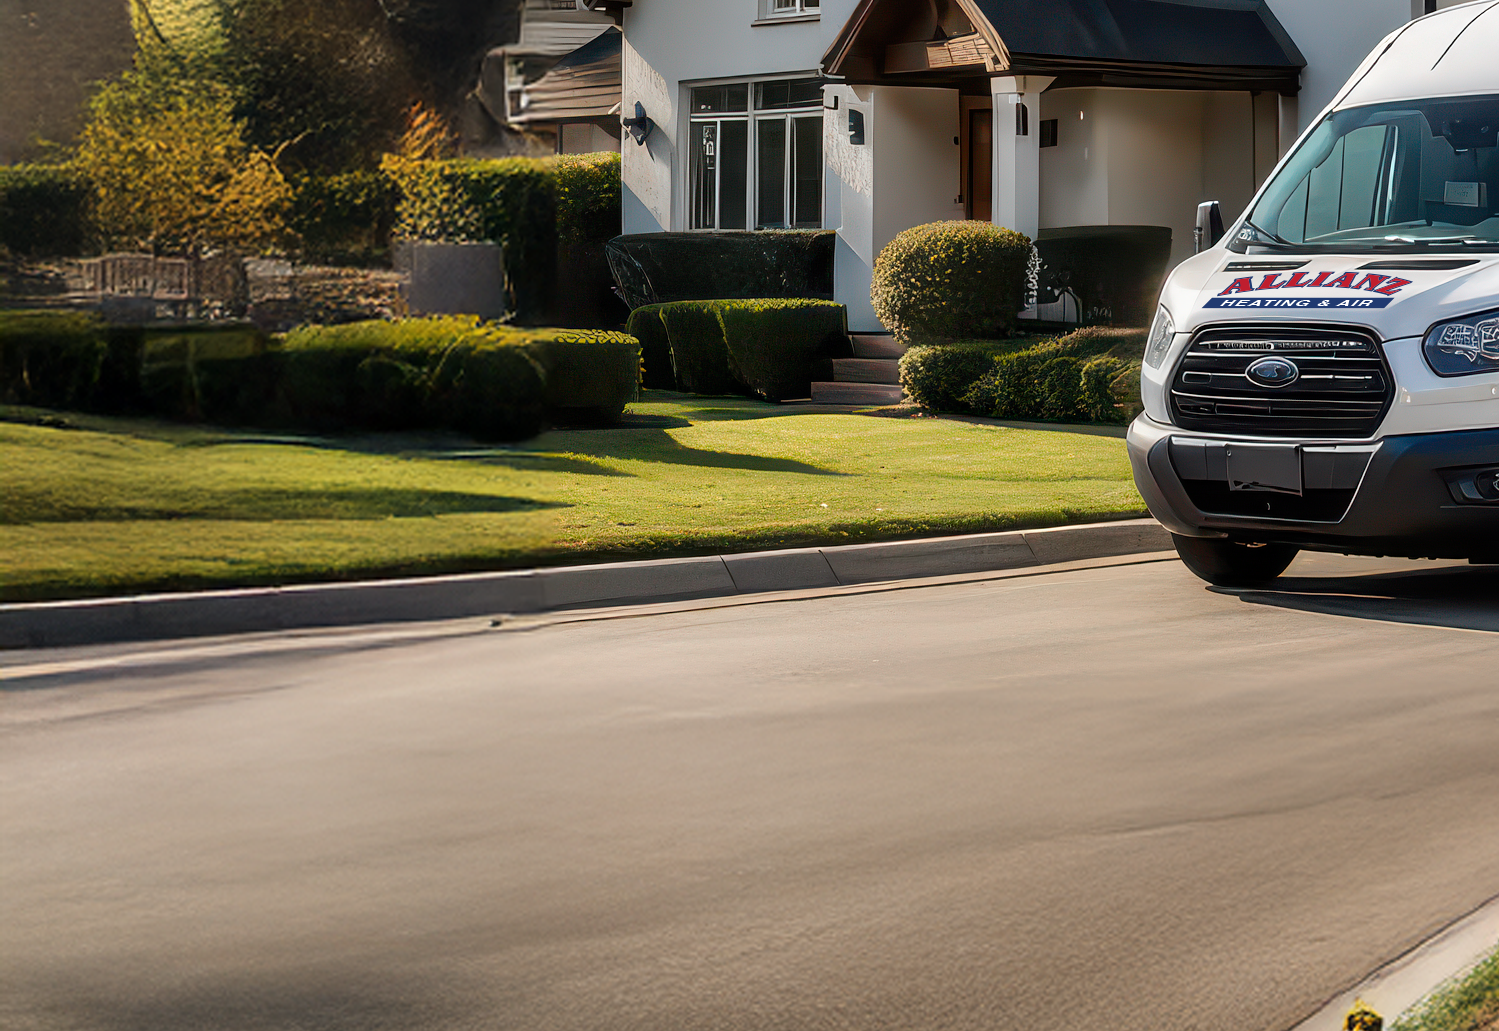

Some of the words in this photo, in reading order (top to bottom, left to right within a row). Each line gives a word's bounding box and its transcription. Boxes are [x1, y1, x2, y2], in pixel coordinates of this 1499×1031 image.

[1216, 271, 1413, 296] ALLIANZ
[1220, 299, 1311, 307] HEATING
[1317, 299, 1331, 307] &
[1335, 299, 1374, 307] AIR
